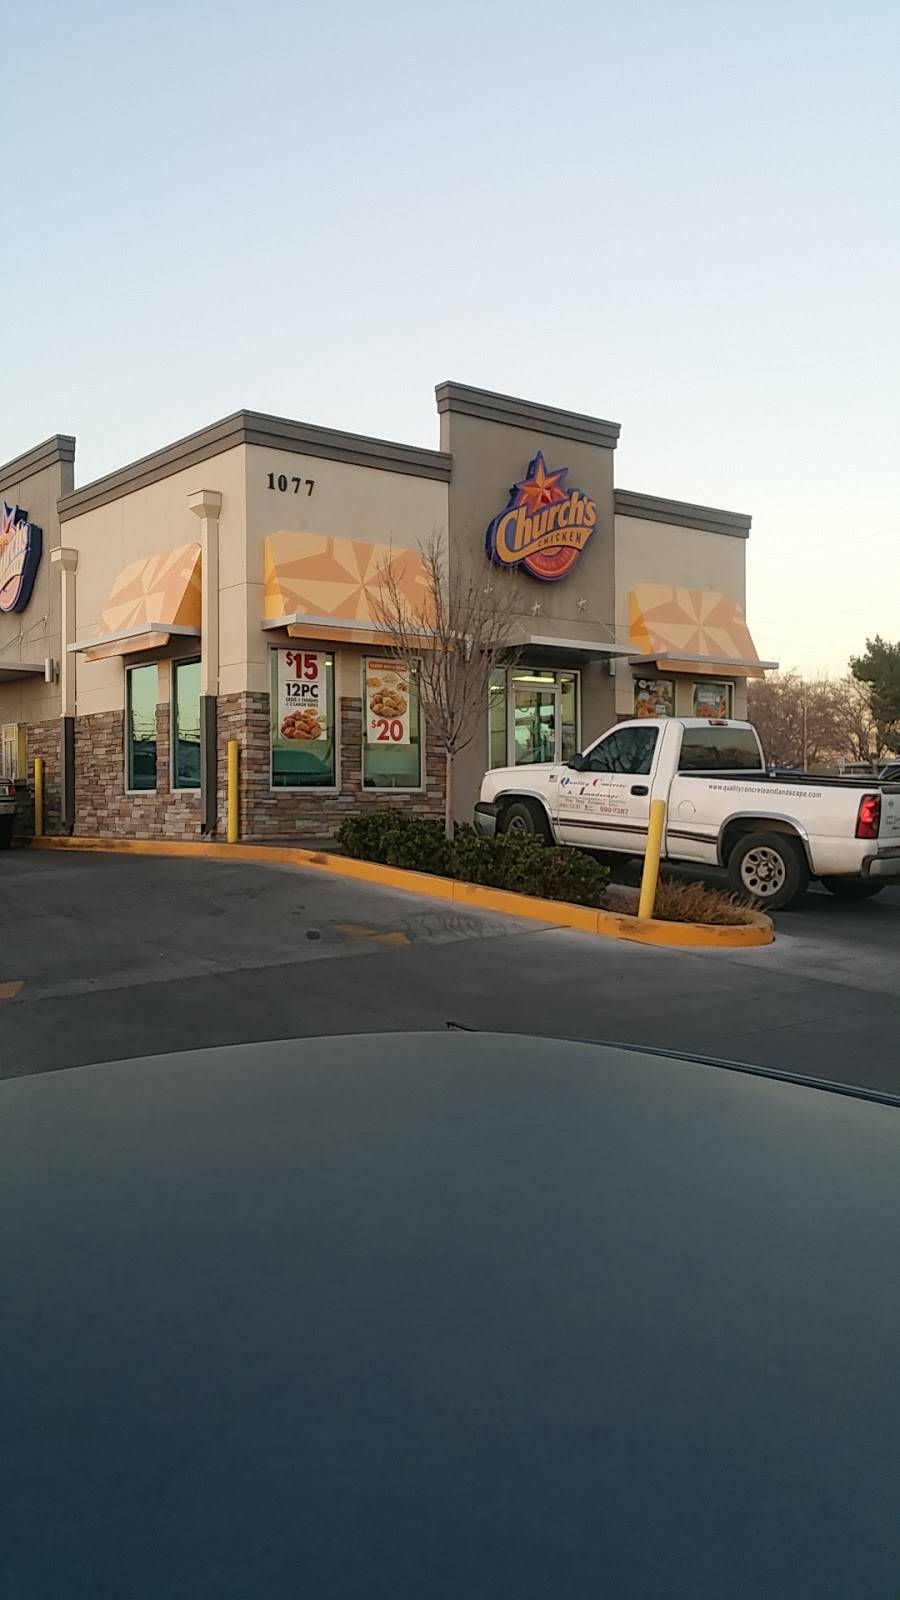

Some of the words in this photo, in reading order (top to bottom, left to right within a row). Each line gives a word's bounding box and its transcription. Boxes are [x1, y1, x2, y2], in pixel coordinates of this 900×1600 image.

[266, 472, 315, 497] 1077
[496, 491, 597, 563] Church's
[537, 530, 582, 547] CHICKEN
[285, 651, 319, 680] $15
[285, 683, 319, 698] 12PC
[371, 719, 404, 742] $20
[560, 777, 590, 788] Quality
[579, 787, 619, 799] Landscape
